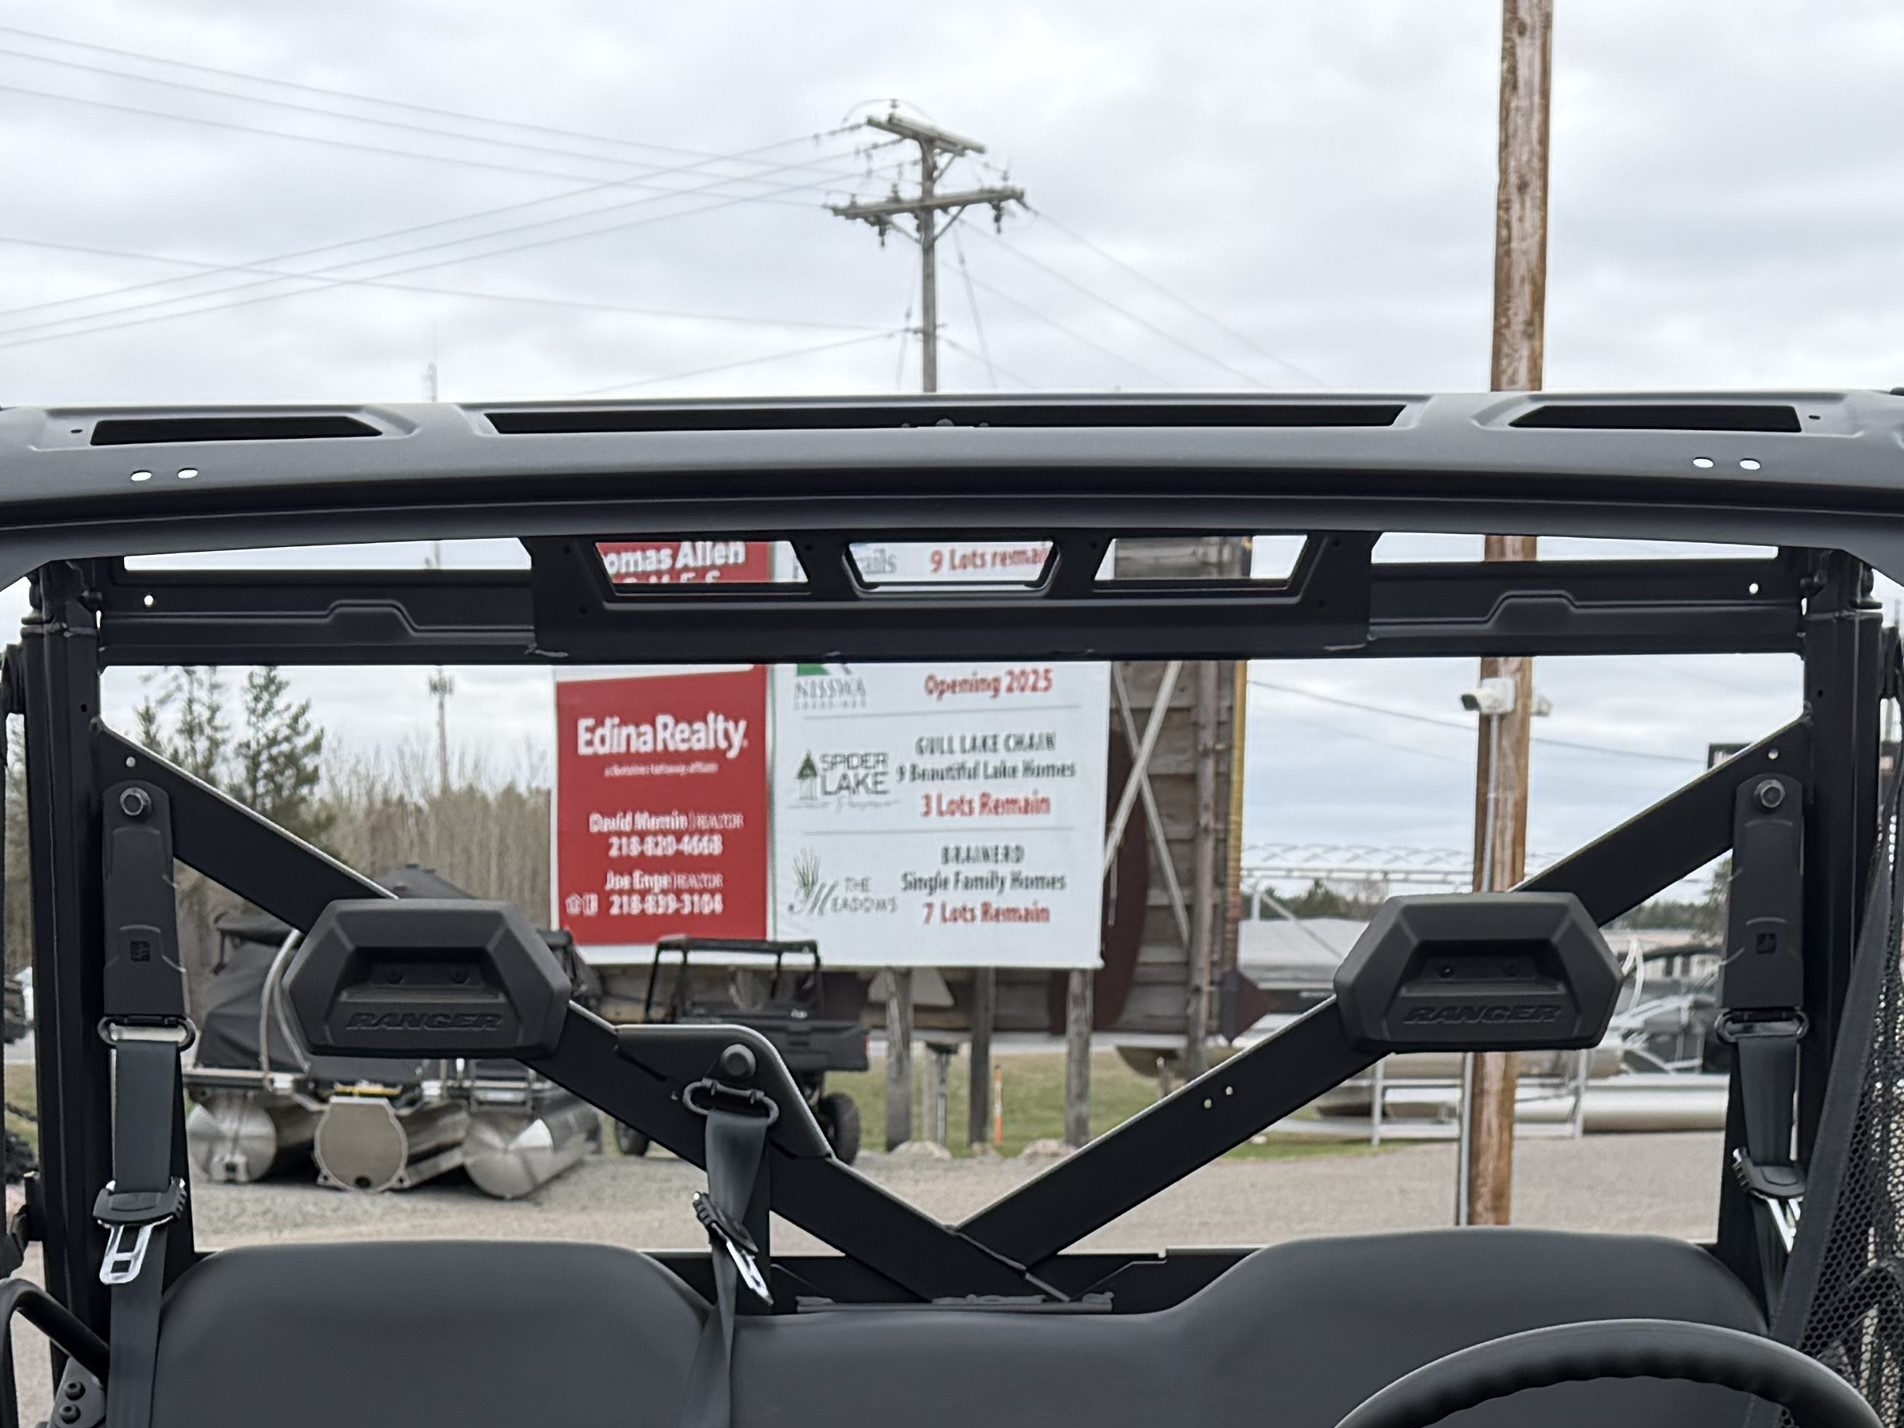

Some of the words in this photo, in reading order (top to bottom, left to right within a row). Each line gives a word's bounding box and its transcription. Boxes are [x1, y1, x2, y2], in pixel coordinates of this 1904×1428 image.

[605, 547, 673, 575] omas
[675, 541, 746, 569] Allen
[930, 550, 944, 573] 9
[949, 548, 987, 571] Lots
[991, 547, 1048, 568] remai
[925, 671, 1003, 700] Opening
[1005, 668, 1053, 694] 2025
[959, 734, 999, 753] LAKE
[820, 752, 889, 771] SPIDER
[909, 760, 980, 782] Beautiful
[983, 759, 1018, 780] Lake
[1022, 758, 1076, 779] Homes
[821, 770, 889, 796] LAKE
[921, 793, 932, 817] 3
[936, 792, 975, 817] Lots
[979, 790, 1051, 816] Remain
[589, 810, 633, 833] David
[901, 870, 949, 896] Single
[953, 869, 1006, 896] Family
[1010, 869, 1067, 890] Homes
[923, 902, 934, 924] 7
[940, 900, 976, 923] Lots
[980, 899, 1051, 923] Remain
[346, 1012, 503, 1031] RANGER
[1403, 1005, 1561, 1025] RANGER
